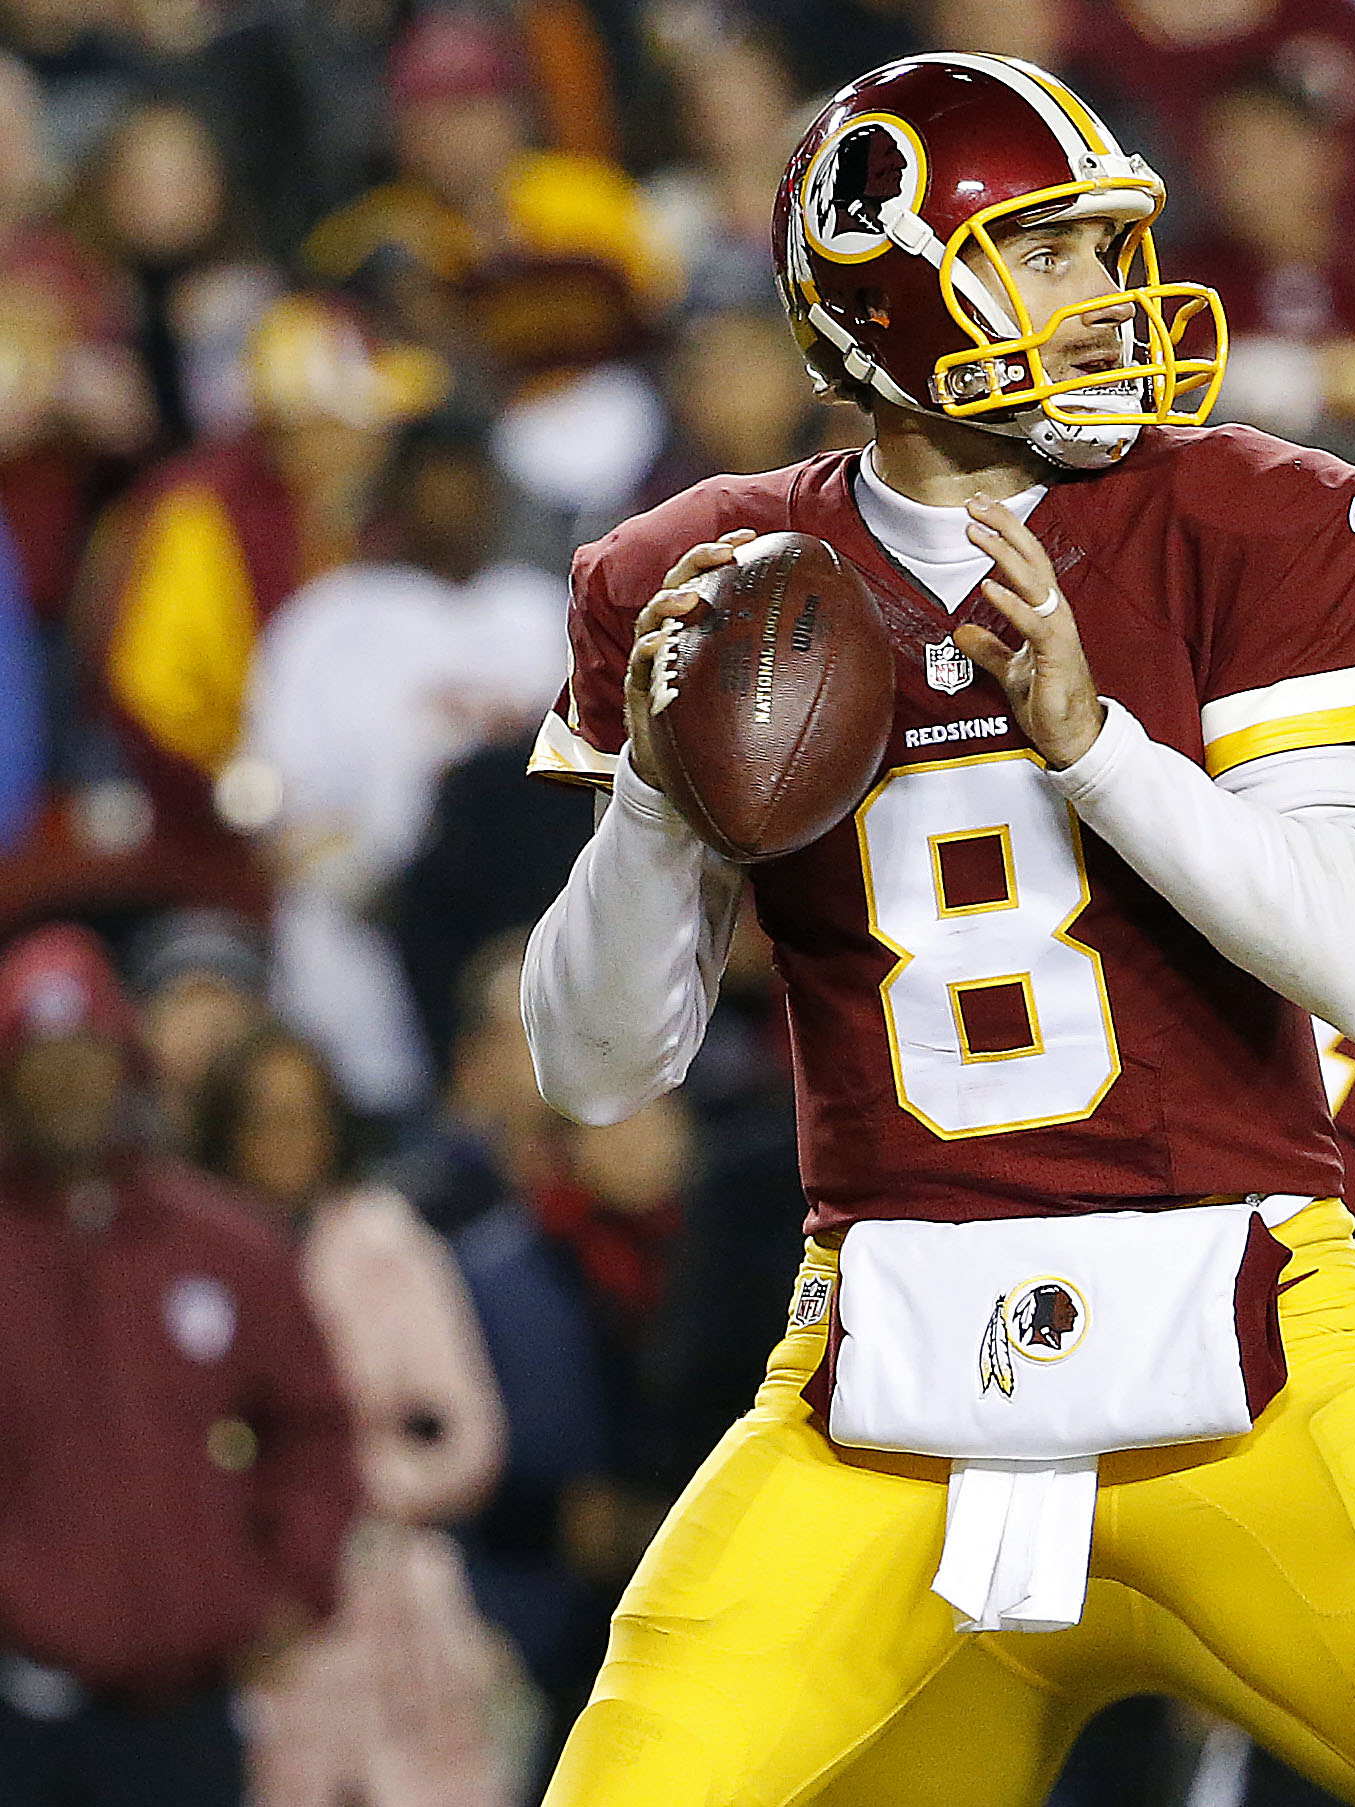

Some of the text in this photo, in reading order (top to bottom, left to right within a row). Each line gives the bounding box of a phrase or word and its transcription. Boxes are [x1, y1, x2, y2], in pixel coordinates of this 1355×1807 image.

[754, 648, 775, 724] NATIONAL
[935, 661, 967, 685] NFL
[905, 716, 1009, 748] REDSKINS
[855, 748, 1122, 1141] 8
